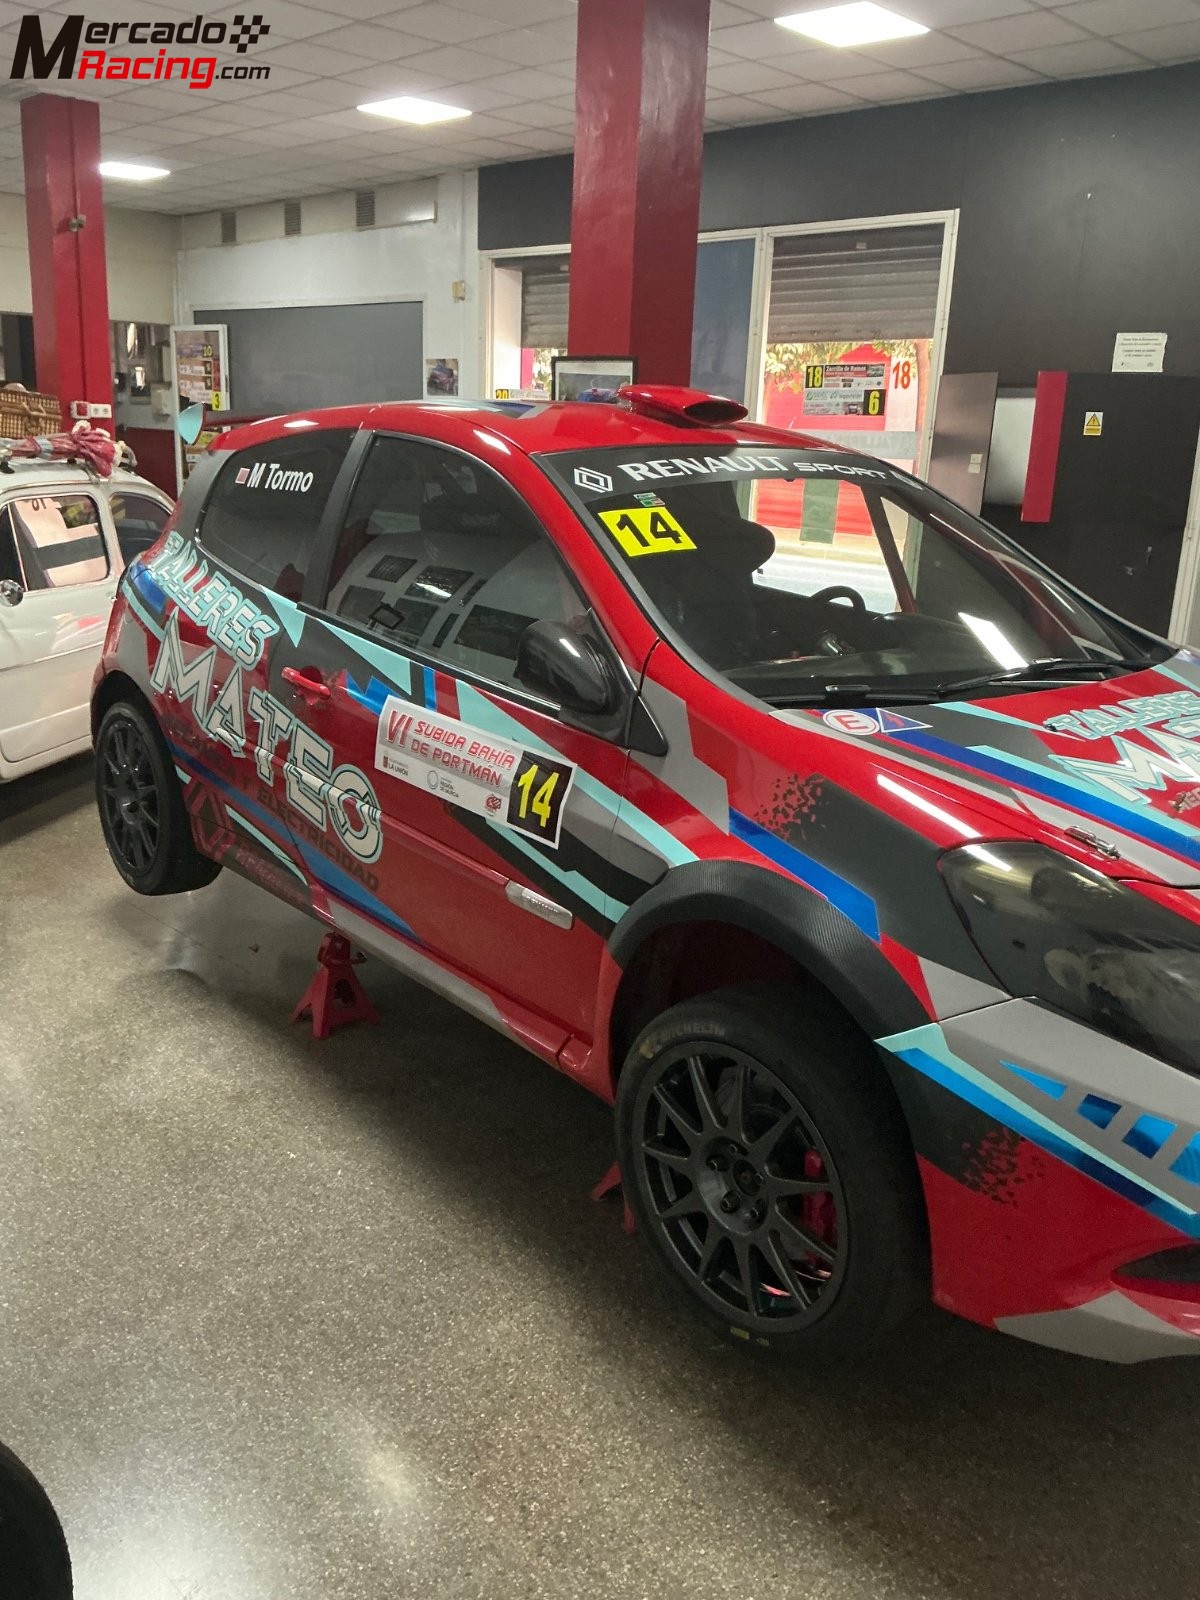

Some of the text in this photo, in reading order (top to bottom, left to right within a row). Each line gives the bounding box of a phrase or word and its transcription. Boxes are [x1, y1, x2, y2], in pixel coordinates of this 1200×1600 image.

[807, 366, 823, 388] 18
[893, 361, 911, 390] 18
[214, 393, 220, 408] 3
[868, 390, 880, 415] 6
[246, 462, 314, 493] M Tormo
[616, 455, 887, 482] RENAULT SPORT
[615, 511, 683, 548] 14
[149, 531, 280, 671] TALLERES
[150, 606, 384, 865] MATEO
[386, 708, 516, 771] VI SUBIDA BAHÍA
[833, 714, 868, 731] E
[410, 737, 503, 788] DE PORTMÁN
[517, 763, 560, 829] 14
[257, 784, 380, 894] ELECTRICIDAD
